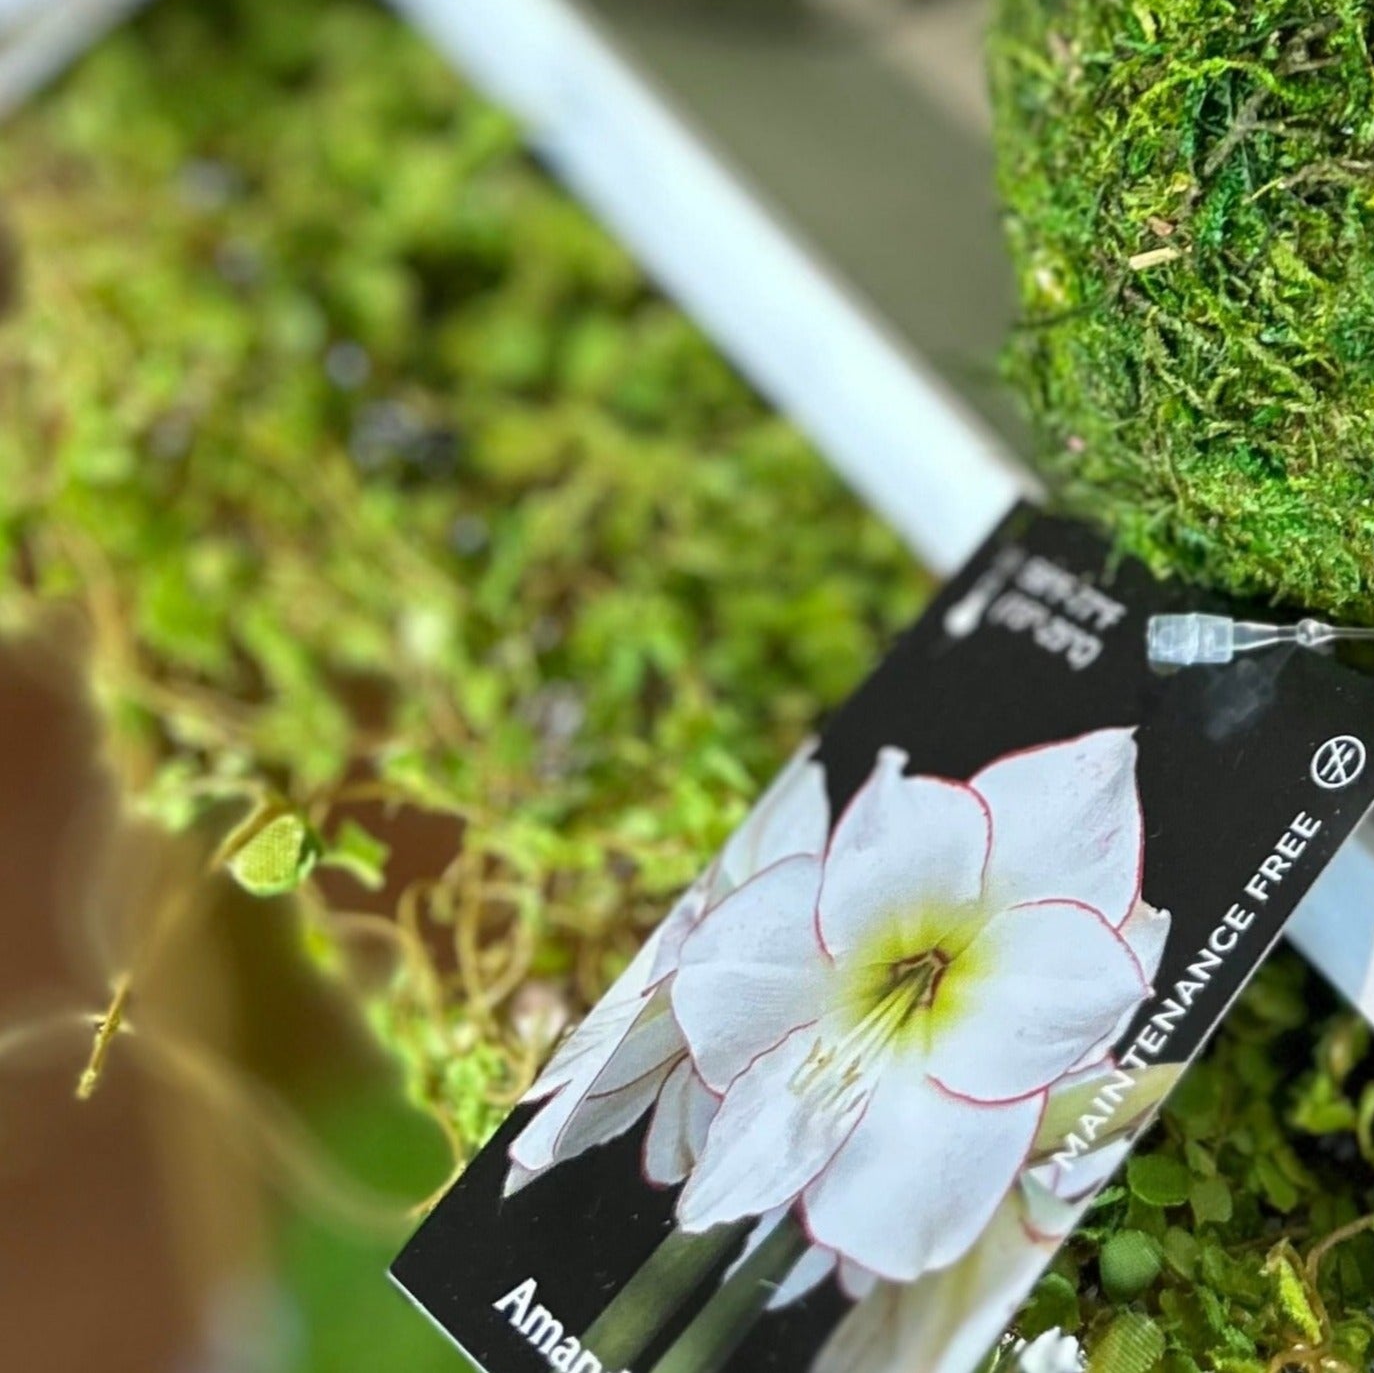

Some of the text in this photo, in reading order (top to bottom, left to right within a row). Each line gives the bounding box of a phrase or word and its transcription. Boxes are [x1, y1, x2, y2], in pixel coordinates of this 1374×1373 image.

[1054, 810, 1322, 1171] MAINTENANCE FREE
[491, 1277, 631, 1373] Aman
